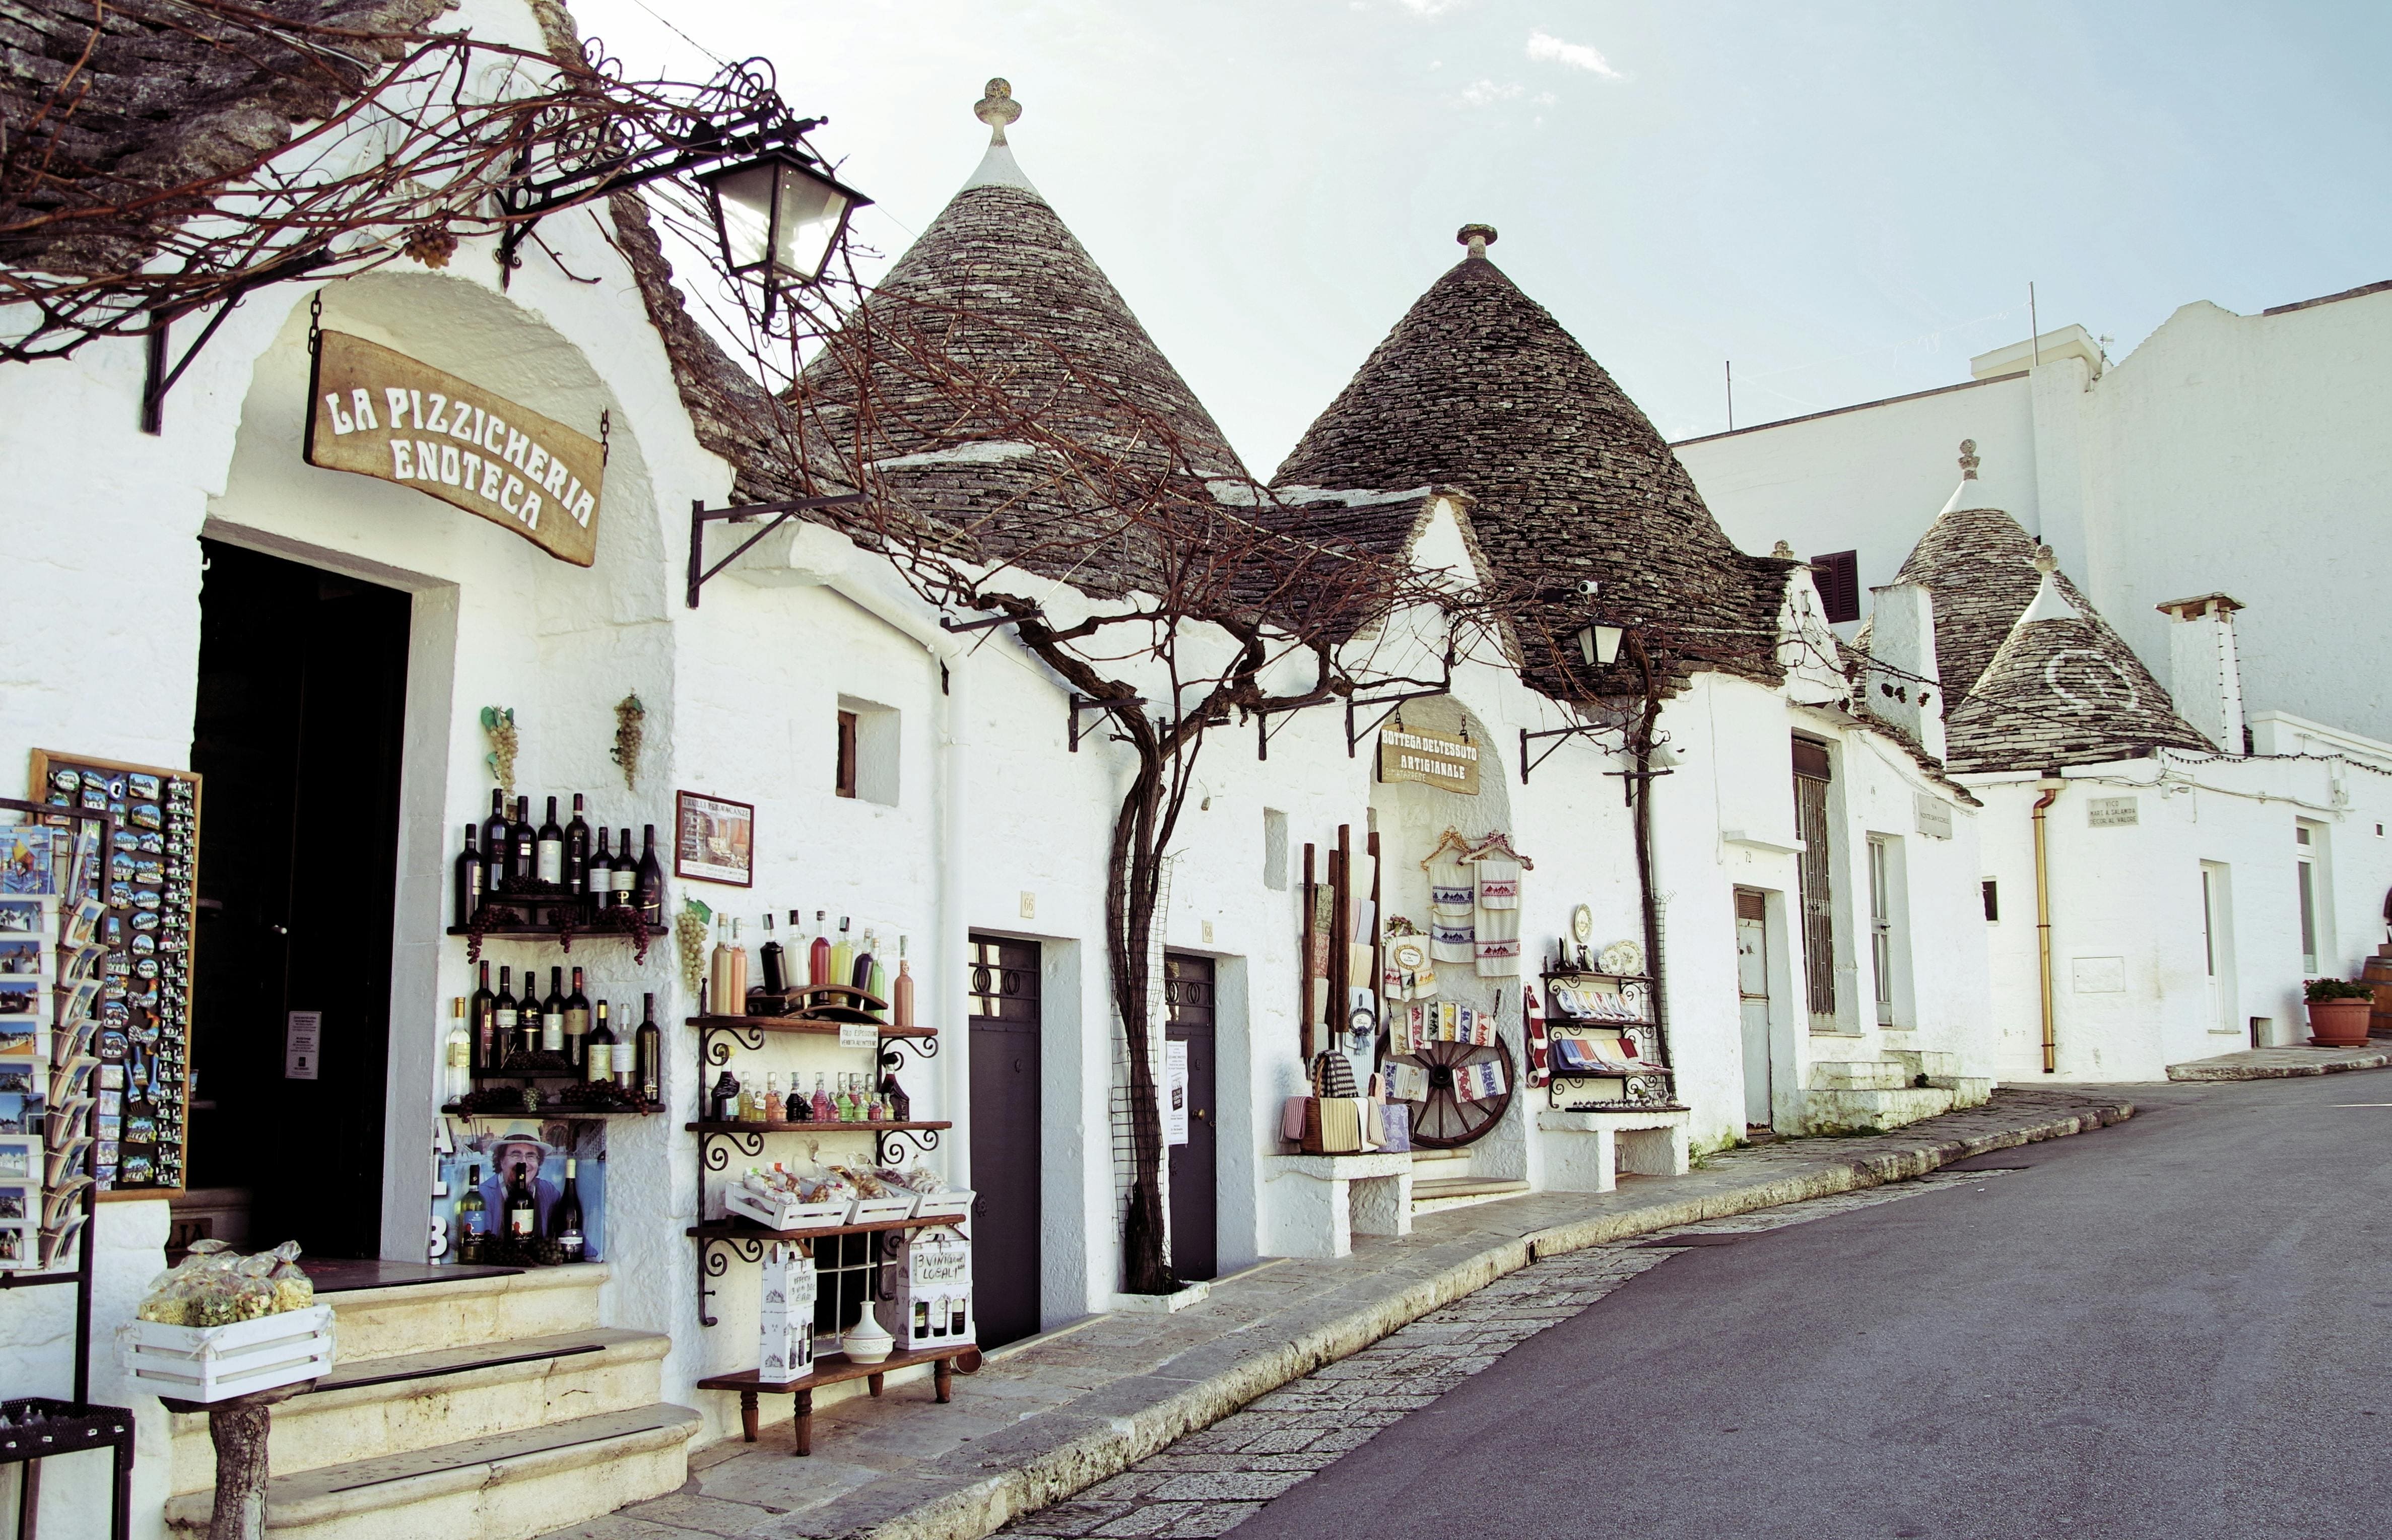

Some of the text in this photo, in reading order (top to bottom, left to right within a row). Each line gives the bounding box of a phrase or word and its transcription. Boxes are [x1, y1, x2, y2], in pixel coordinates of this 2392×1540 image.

[325, 387, 596, 529] LA PIZZICHERIA
[390, 439, 543, 531] ENOTECA
[1439, 740, 1477, 761] TESSUTO
[1401, 754, 1466, 780] ARTIGIANALE
[683, 798, 749, 818] TRULLI PER VACANZE
[1745, 851, 1752, 863] 72
[1024, 898, 1033, 911] 66
[1205, 926, 1212, 938] 68
[918, 1254, 924, 1268] 3
[926, 1252, 947, 1267] VINI
[923, 1267, 958, 1280] LOCALI
